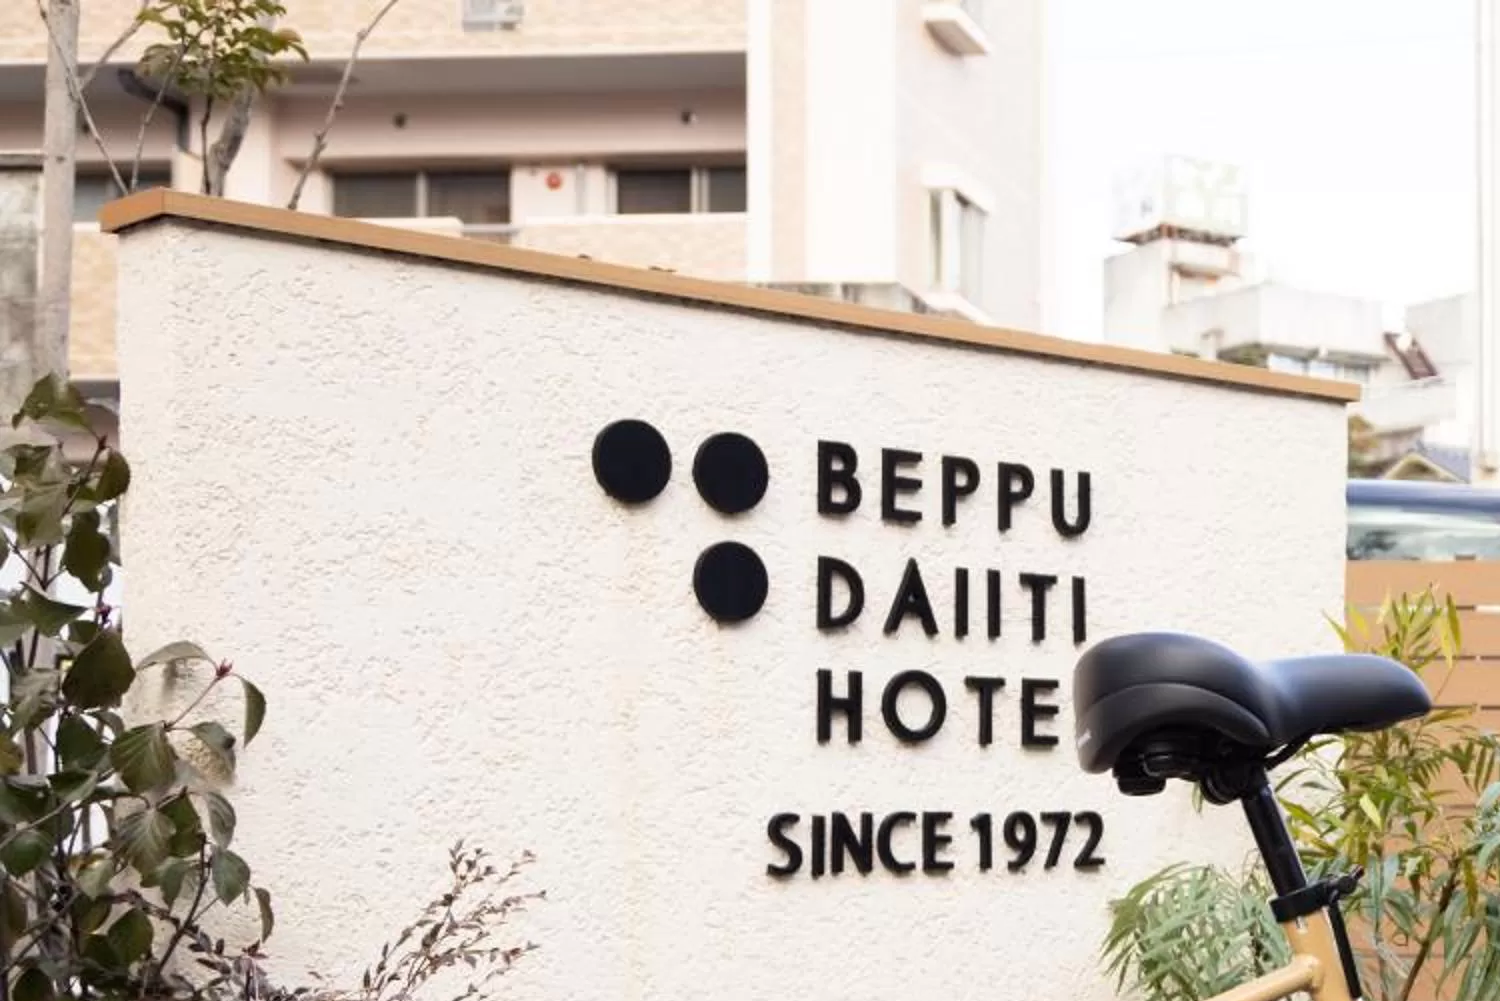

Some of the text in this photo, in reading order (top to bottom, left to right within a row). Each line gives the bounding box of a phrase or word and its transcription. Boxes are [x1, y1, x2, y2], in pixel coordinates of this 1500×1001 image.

[818, 441, 1090, 539] BEPPU
[817, 557, 1086, 645] DAIITI
[817, 670, 1058, 750] HOTE
[768, 812, 1104, 880] SINCE 1972
